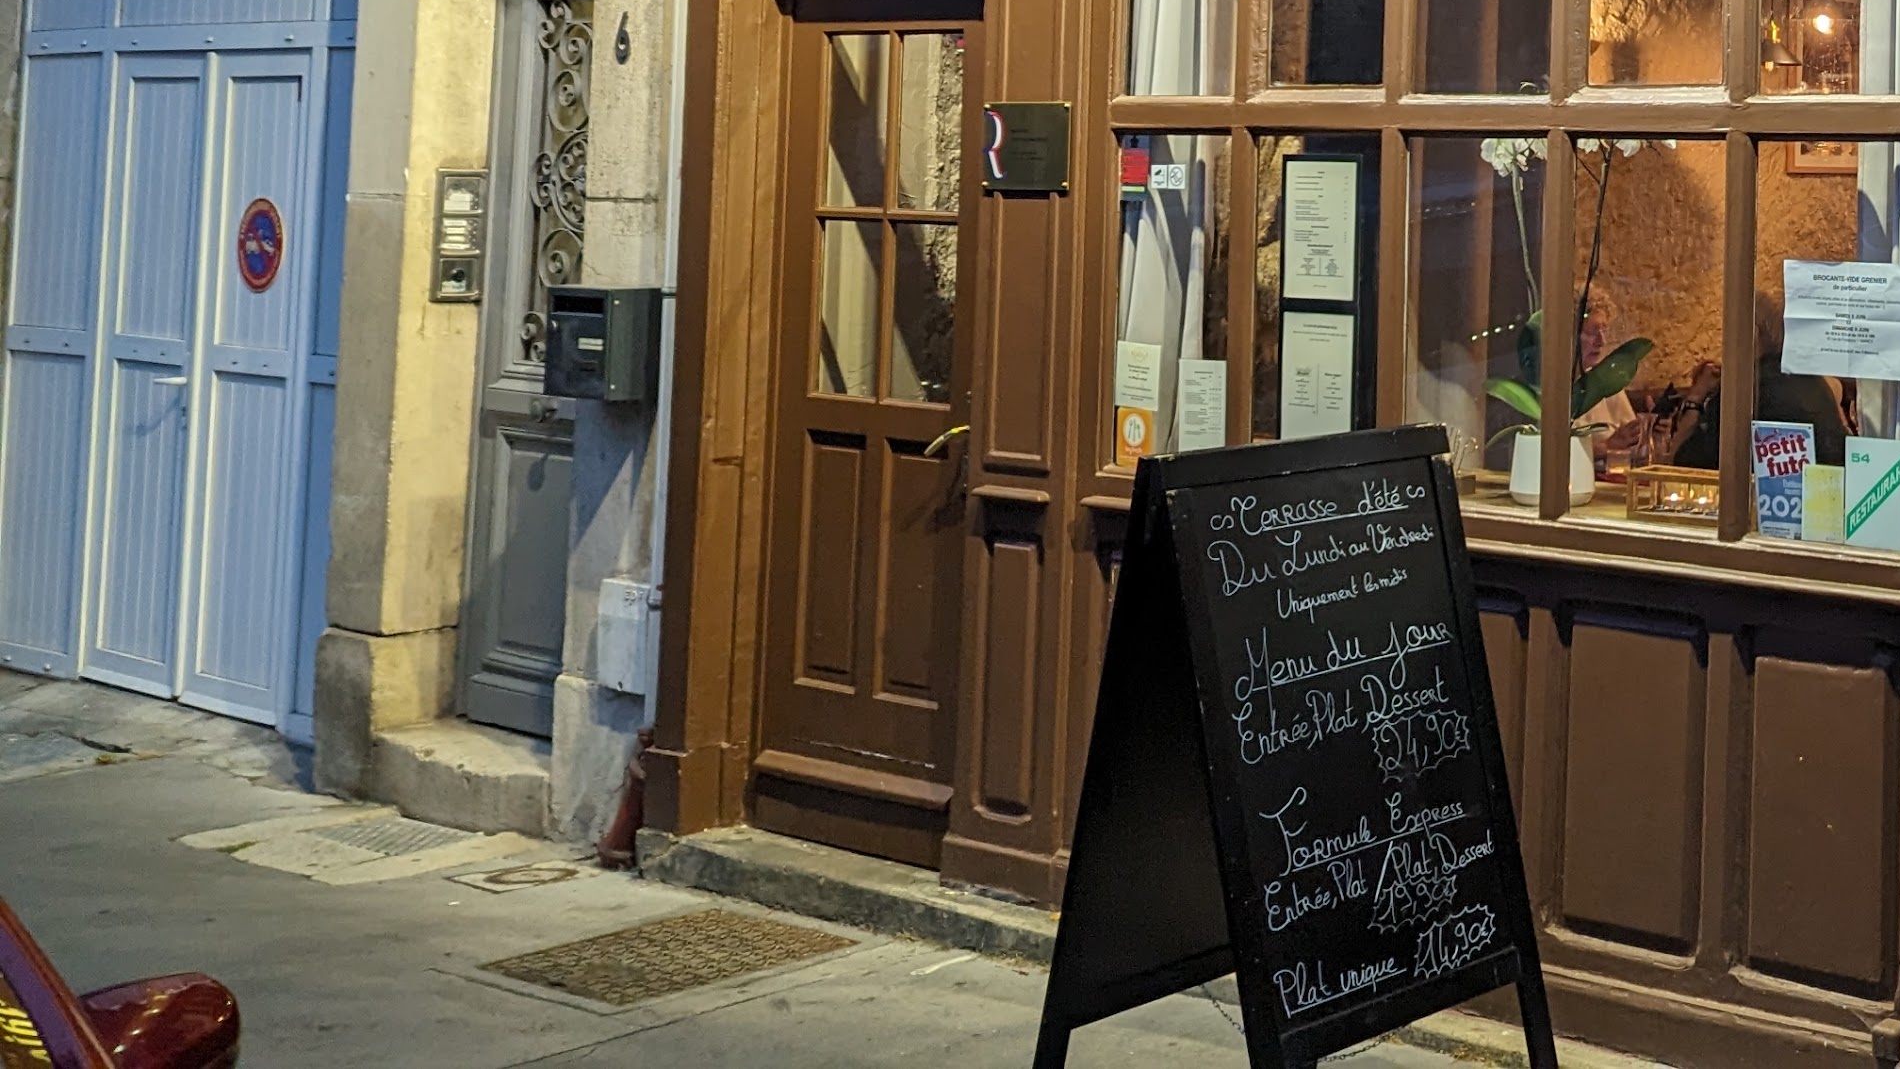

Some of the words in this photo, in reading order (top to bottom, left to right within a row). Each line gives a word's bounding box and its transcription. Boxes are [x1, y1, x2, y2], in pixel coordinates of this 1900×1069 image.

[615, 11, 630, 65] 6
[1755, 434, 1807, 463] petit
[1851, 453, 1870, 464] 54
[1231, 495, 1337, 535] Terrasse
[1358, 478, 1401, 515] d'été
[1758, 494, 1802, 519] 202
[1207, 540, 1277, 596] Du
[1275, 530, 1346, 576] Lundi
[1349, 541, 1370, 556] au
[1367, 523, 1434, 554] Vendredi
[1277, 576, 1359, 623] Uniquement
[1380, 567, 1408, 587] midis
[1235, 627, 1318, 703] Menu
[1327, 630, 1367, 669] du
[1259, 787, 1378, 877] Formule
[1385, 792, 1463, 837] Express
[1273, 960, 1332, 1019] Plat
[1340, 957, 1398, 993] unique
